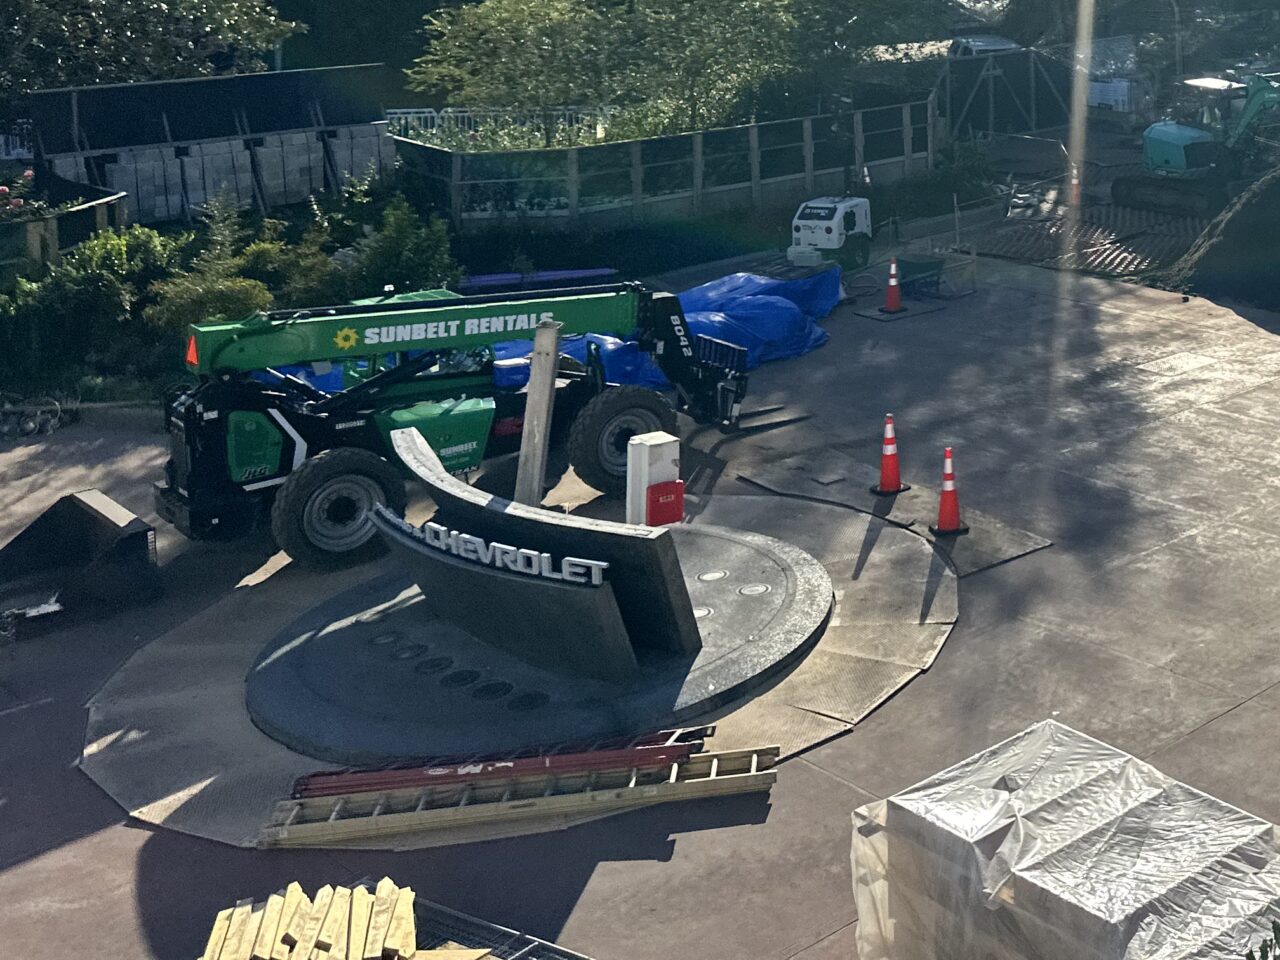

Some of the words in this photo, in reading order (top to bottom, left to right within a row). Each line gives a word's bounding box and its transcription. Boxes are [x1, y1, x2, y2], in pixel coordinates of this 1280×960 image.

[364, 320, 460, 344] SUNBELT
[670, 315, 693, 357] 8042
[440, 441, 478, 456] SUNBELT
[425, 522, 609, 584] CHEVROLET
